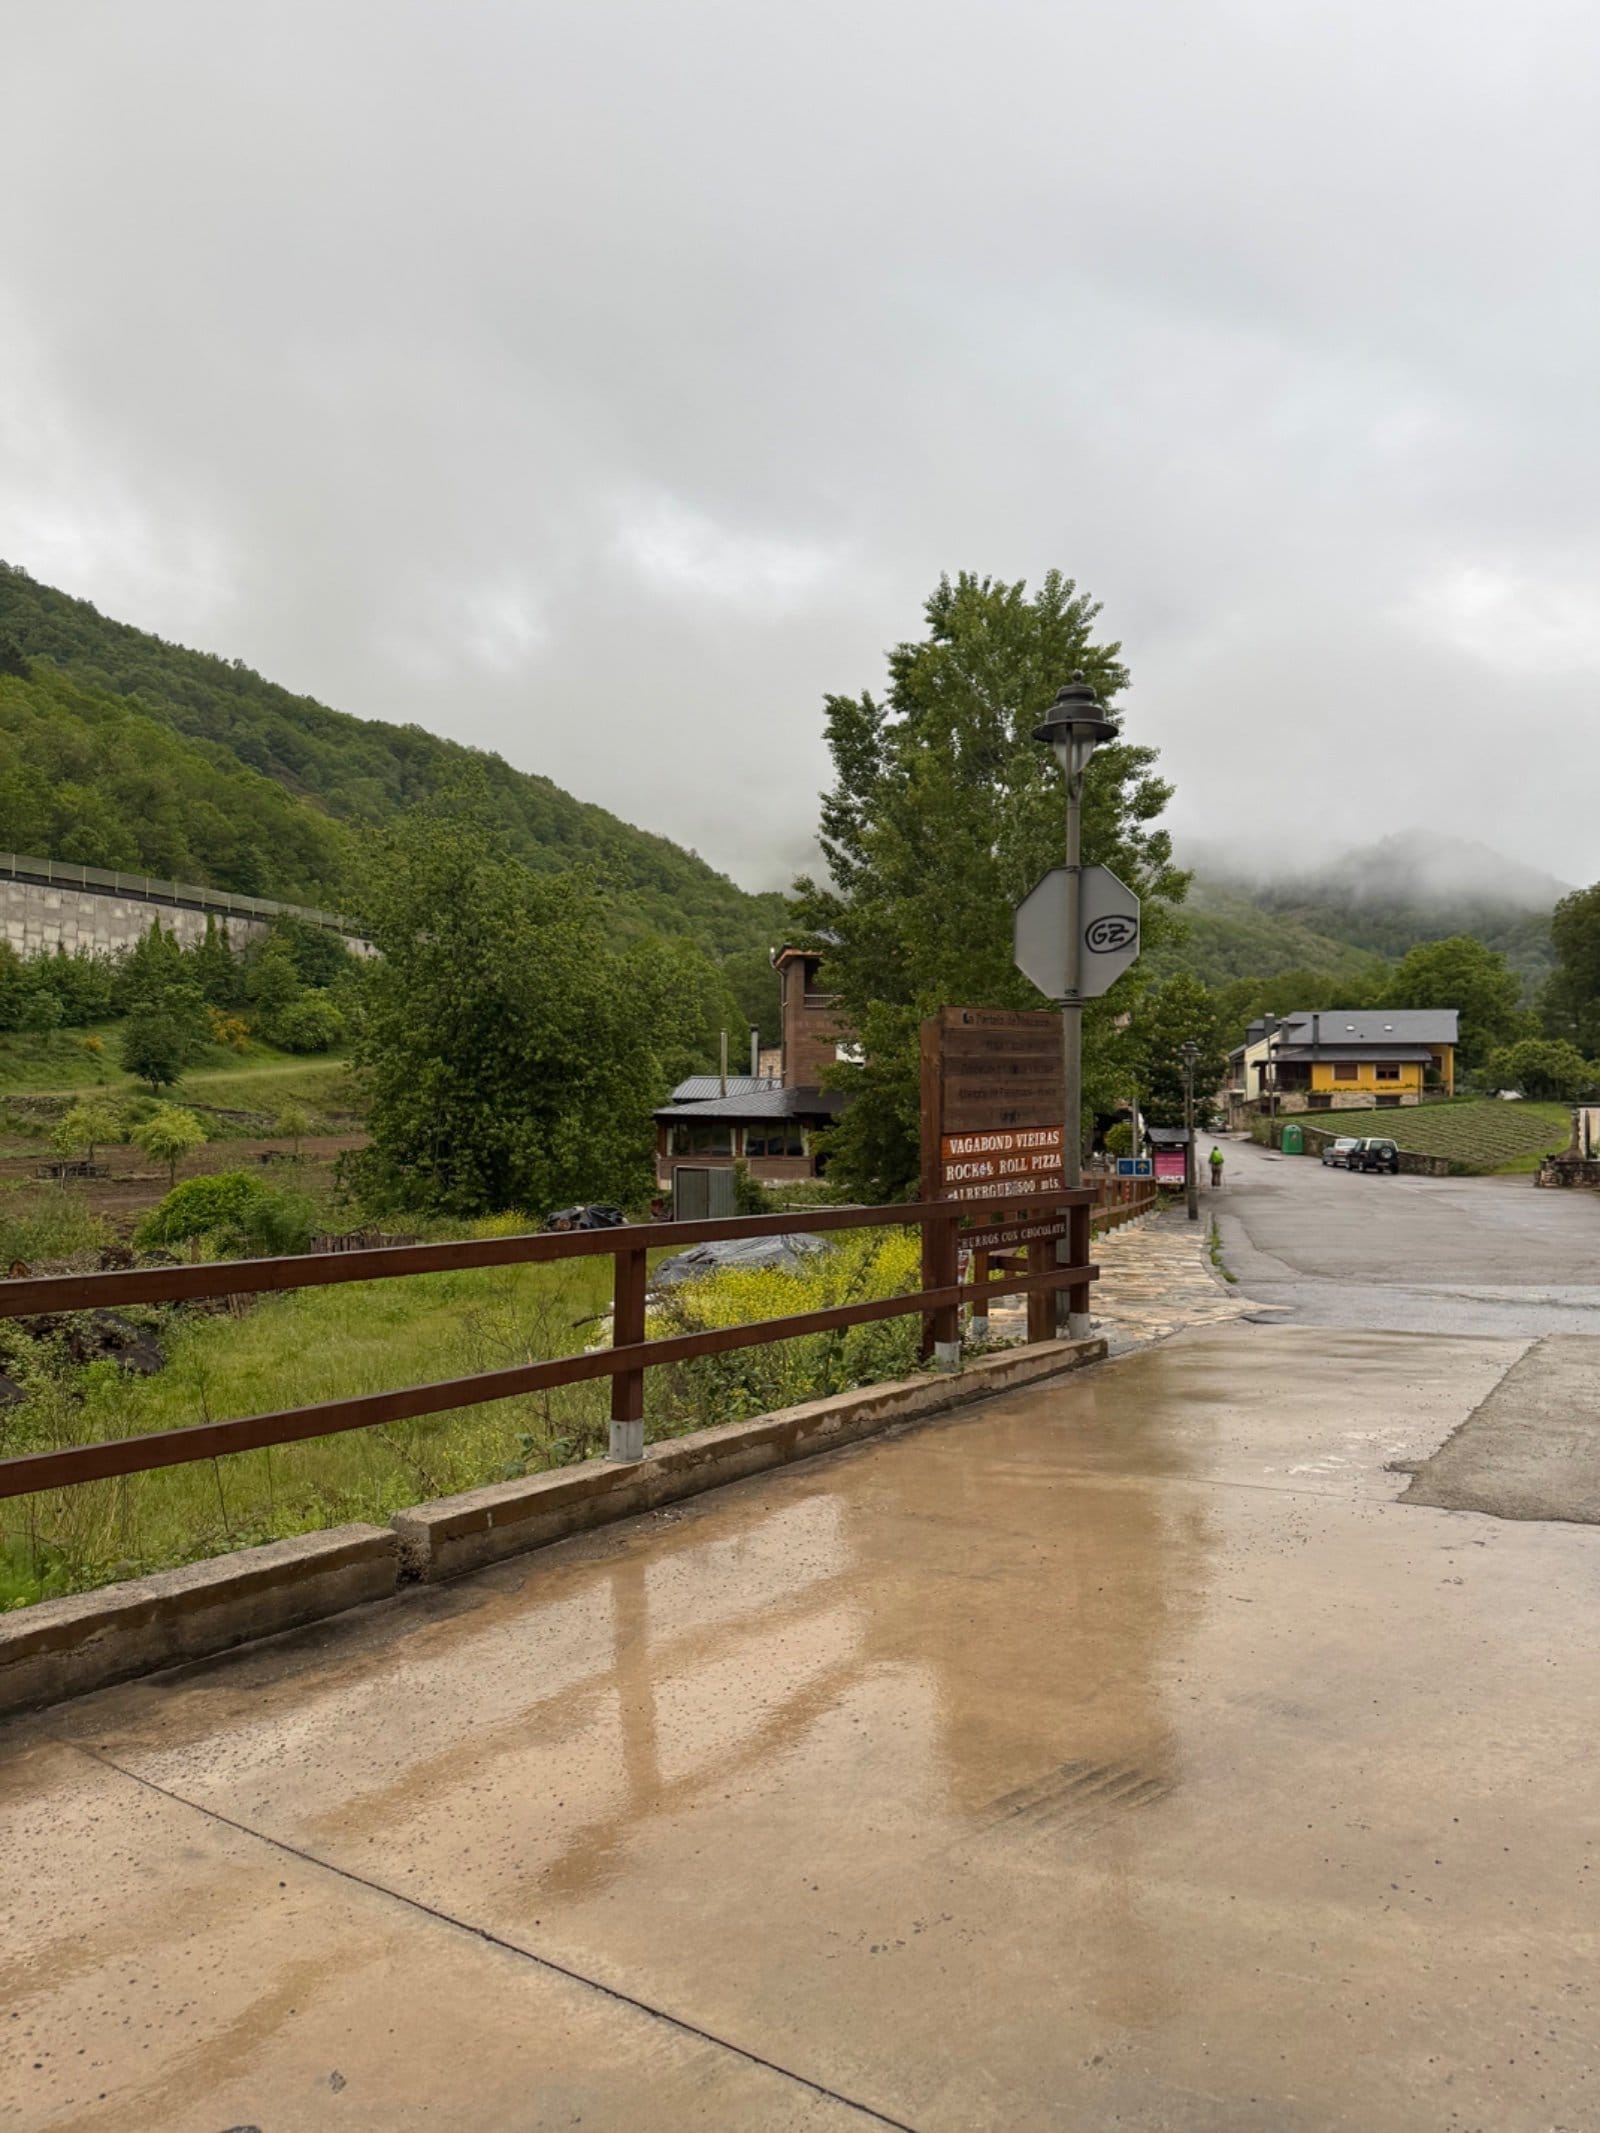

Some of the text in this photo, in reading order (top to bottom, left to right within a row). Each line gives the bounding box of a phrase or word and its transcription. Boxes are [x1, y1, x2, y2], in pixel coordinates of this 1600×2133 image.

[950, 1131, 1060, 1154] VAGABOND VIEIRAS
[999, 1157, 1028, 1174] ROLL
[1032, 1154, 1062, 1169] PIZZA
